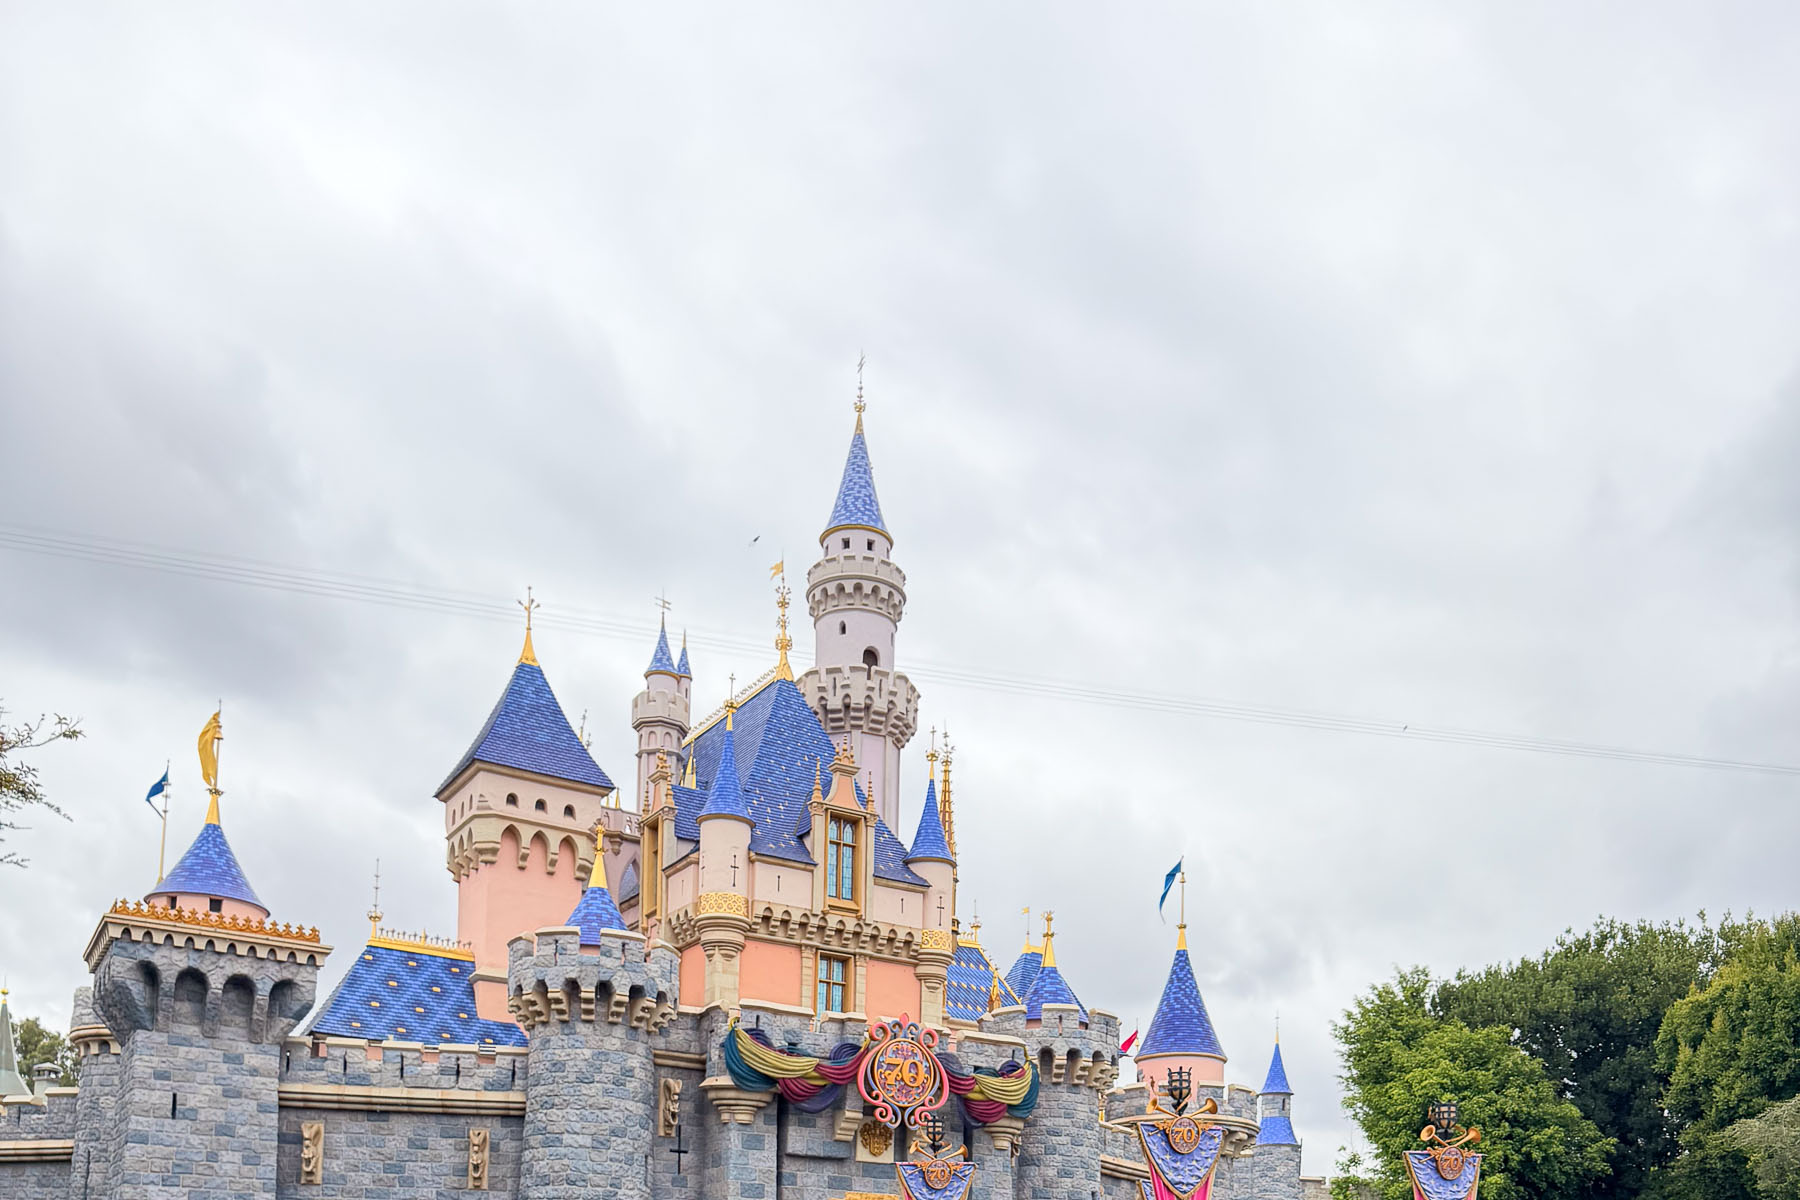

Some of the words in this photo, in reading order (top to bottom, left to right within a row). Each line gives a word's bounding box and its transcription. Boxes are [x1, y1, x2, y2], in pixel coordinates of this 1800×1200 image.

[884, 1057, 925, 1087] 70
[1174, 1127, 1195, 1143] 70
[1443, 1155, 1460, 1170] 70
[928, 1167, 949, 1180] 70
